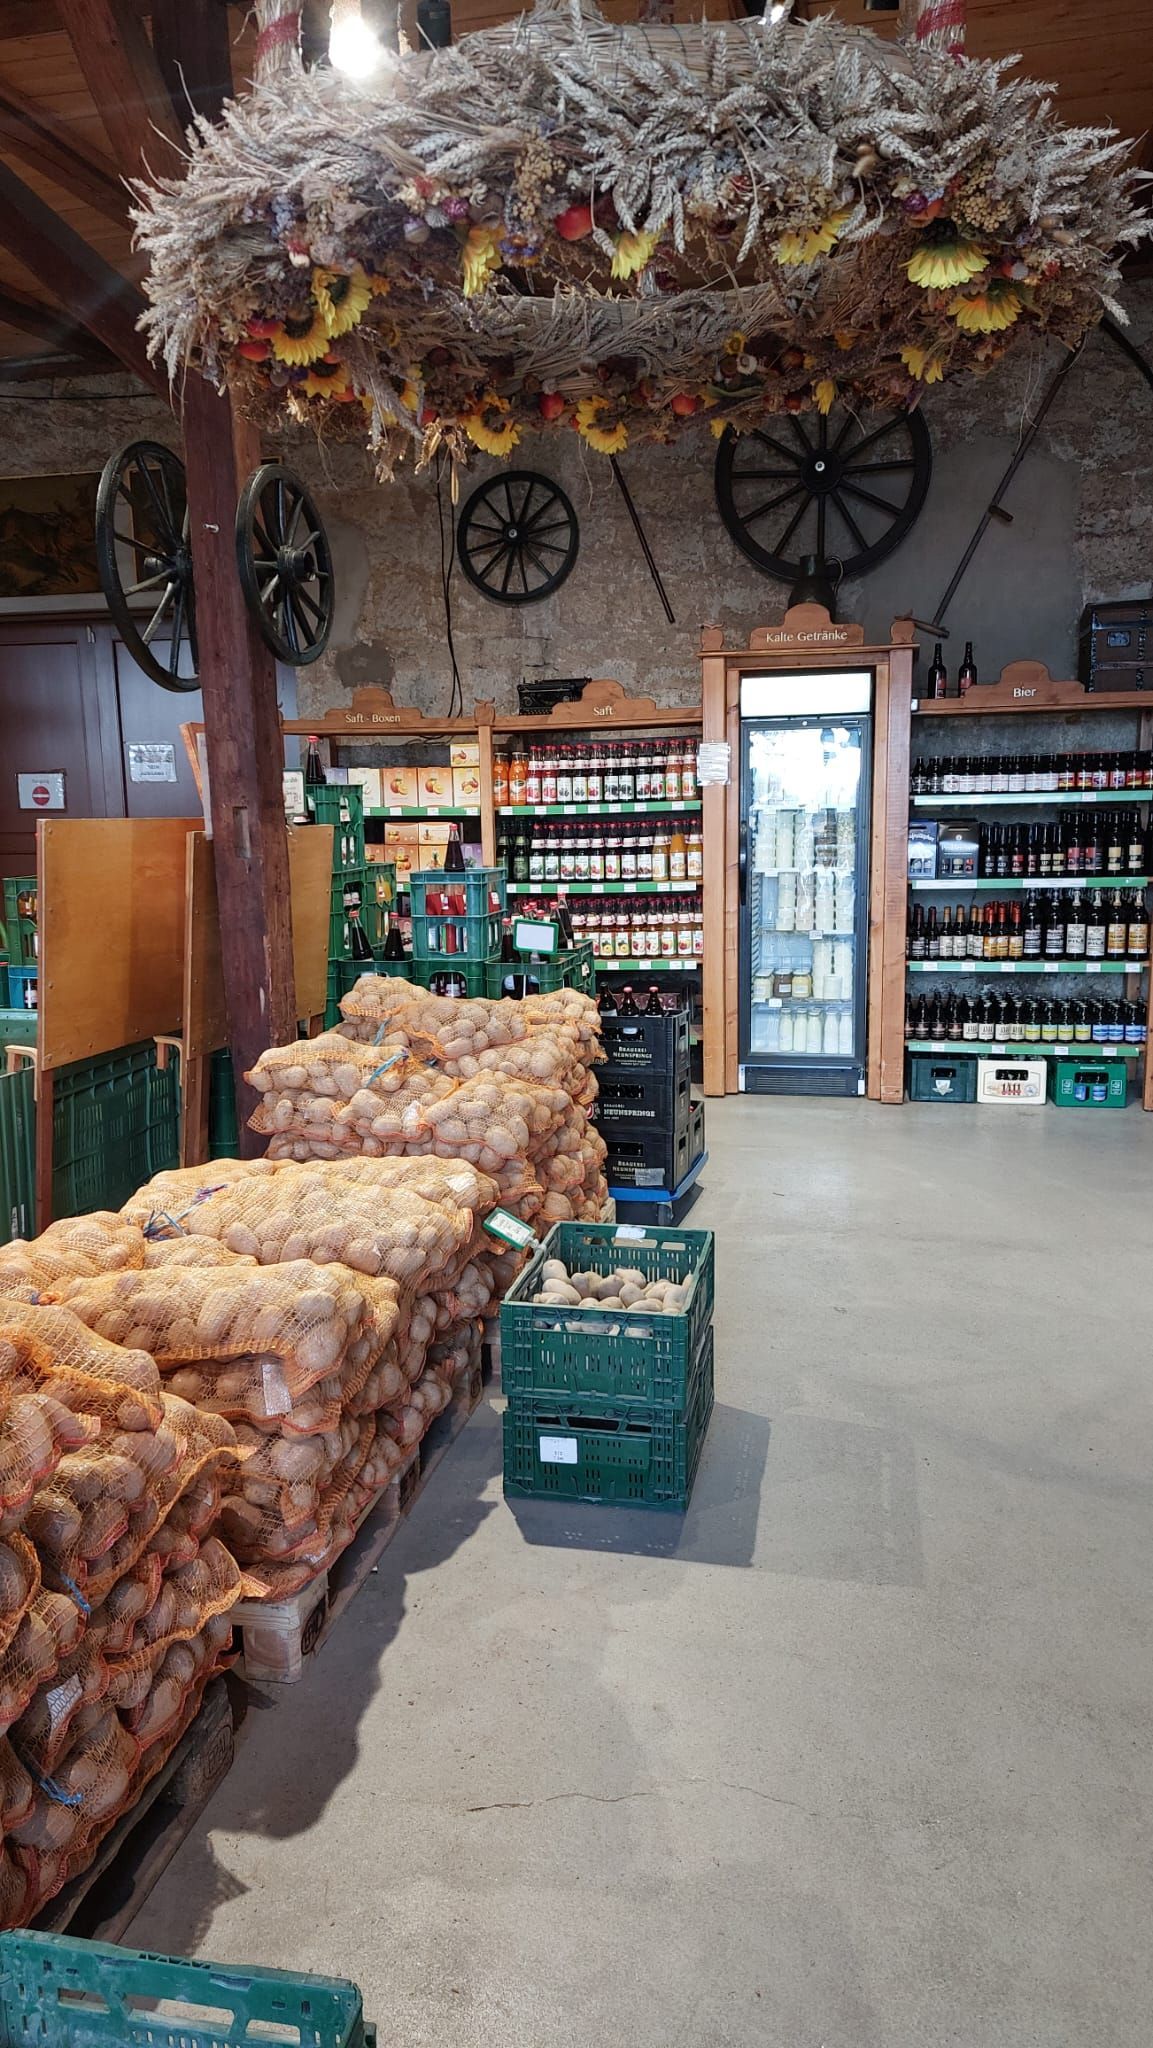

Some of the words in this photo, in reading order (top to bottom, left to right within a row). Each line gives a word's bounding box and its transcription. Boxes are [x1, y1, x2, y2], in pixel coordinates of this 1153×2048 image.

[766, 631, 793, 643] Kalte
[796, 629, 848, 642] Getränke
[1013, 686, 1037, 697] Bier
[593, 705, 614, 716] Saft
[345, 712, 364, 723] Saft
[372, 712, 401, 723] Boxen
[612, 1051, 652, 1059] NEUNSPRINGE
[603, 1108, 656, 1117] NEUNSPRINGE
